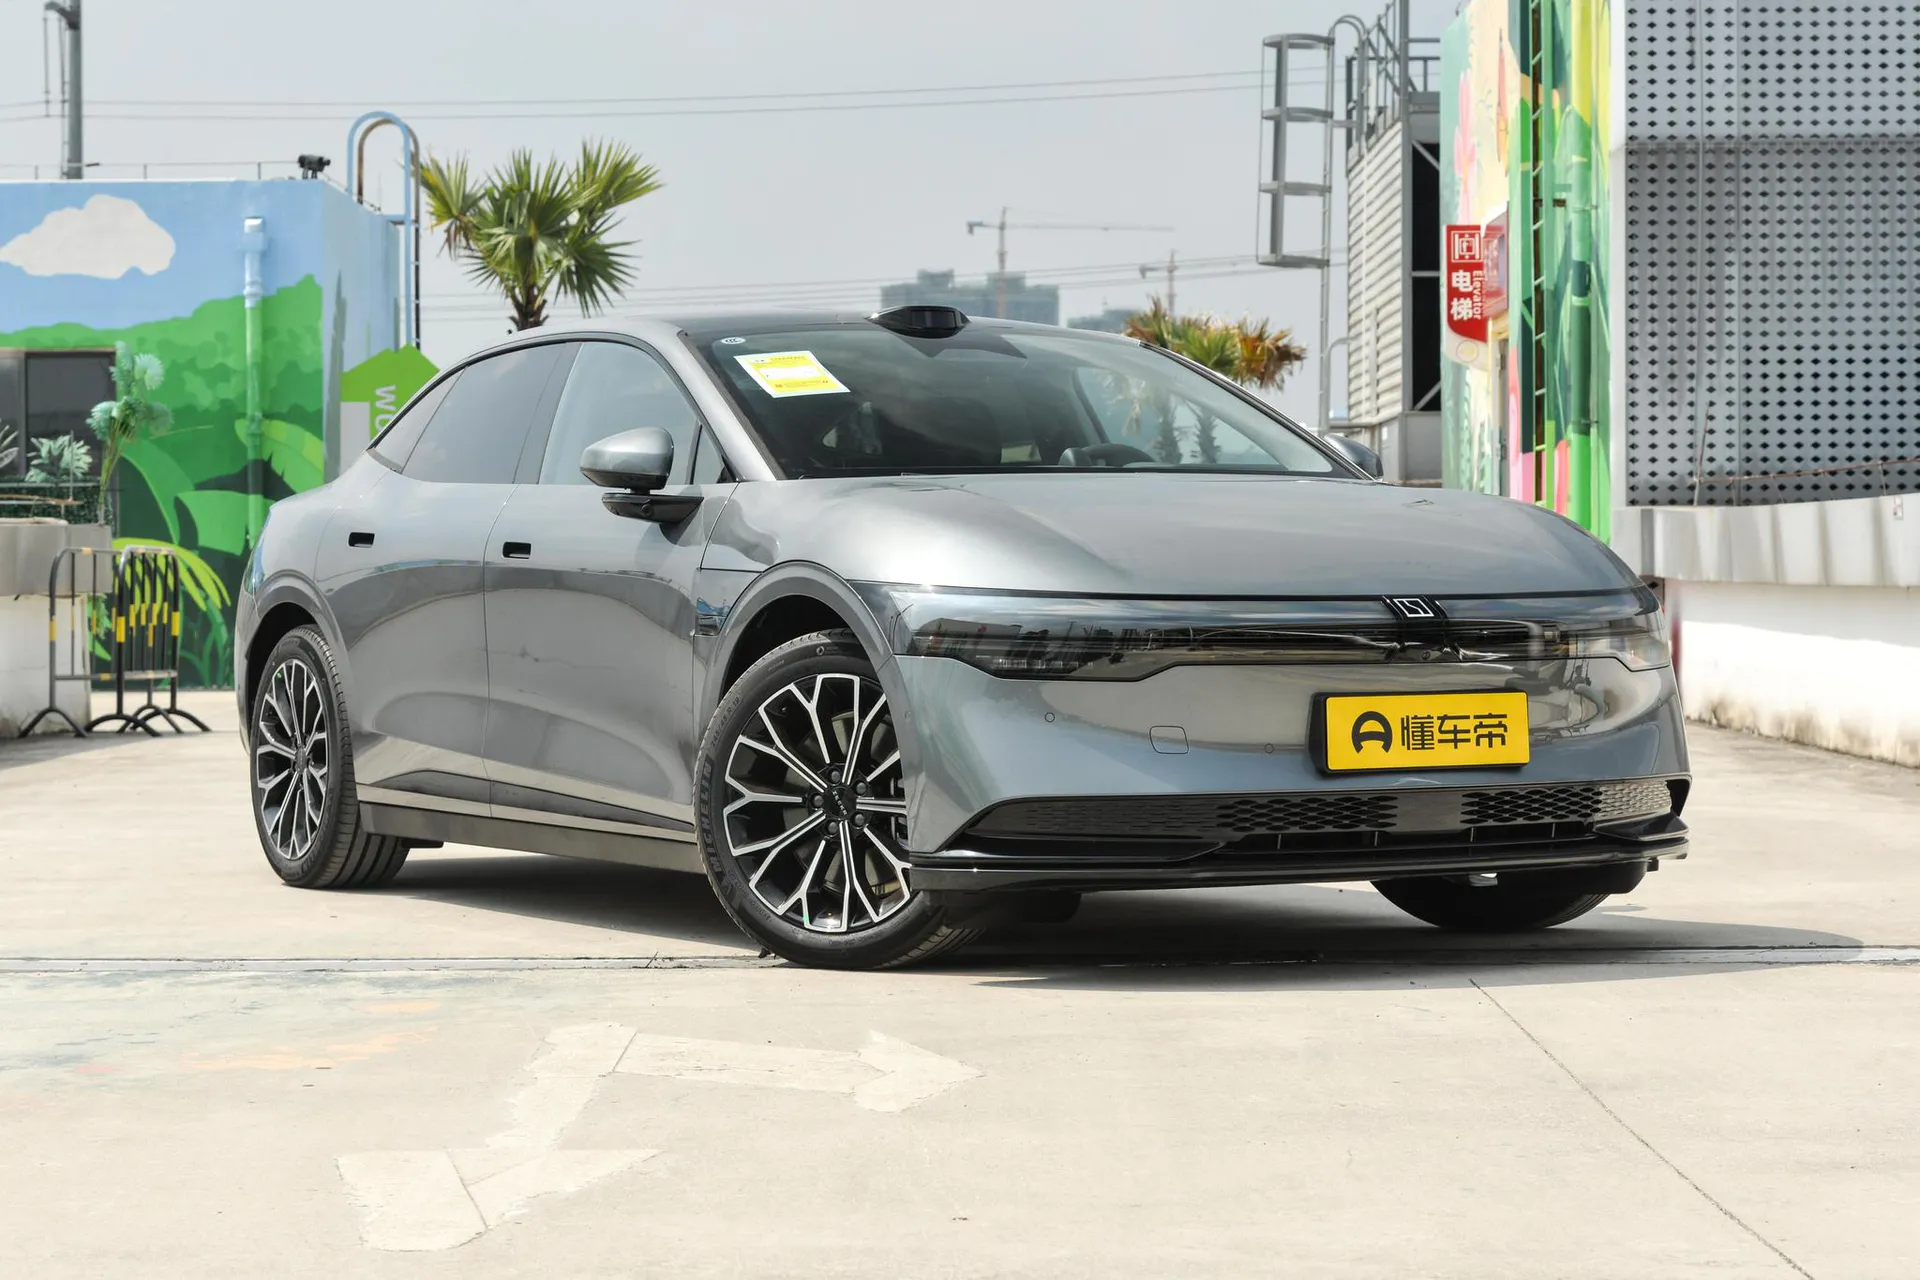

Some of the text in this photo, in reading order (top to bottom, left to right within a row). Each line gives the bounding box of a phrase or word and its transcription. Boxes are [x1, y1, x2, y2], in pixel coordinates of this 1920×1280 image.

[1450, 269, 1473, 320] 电梯
[1472, 270, 1483, 320] Elevator
[1400, 712, 1508, 751] 懂车帝
[700, 760, 721, 873] MICHELIN
